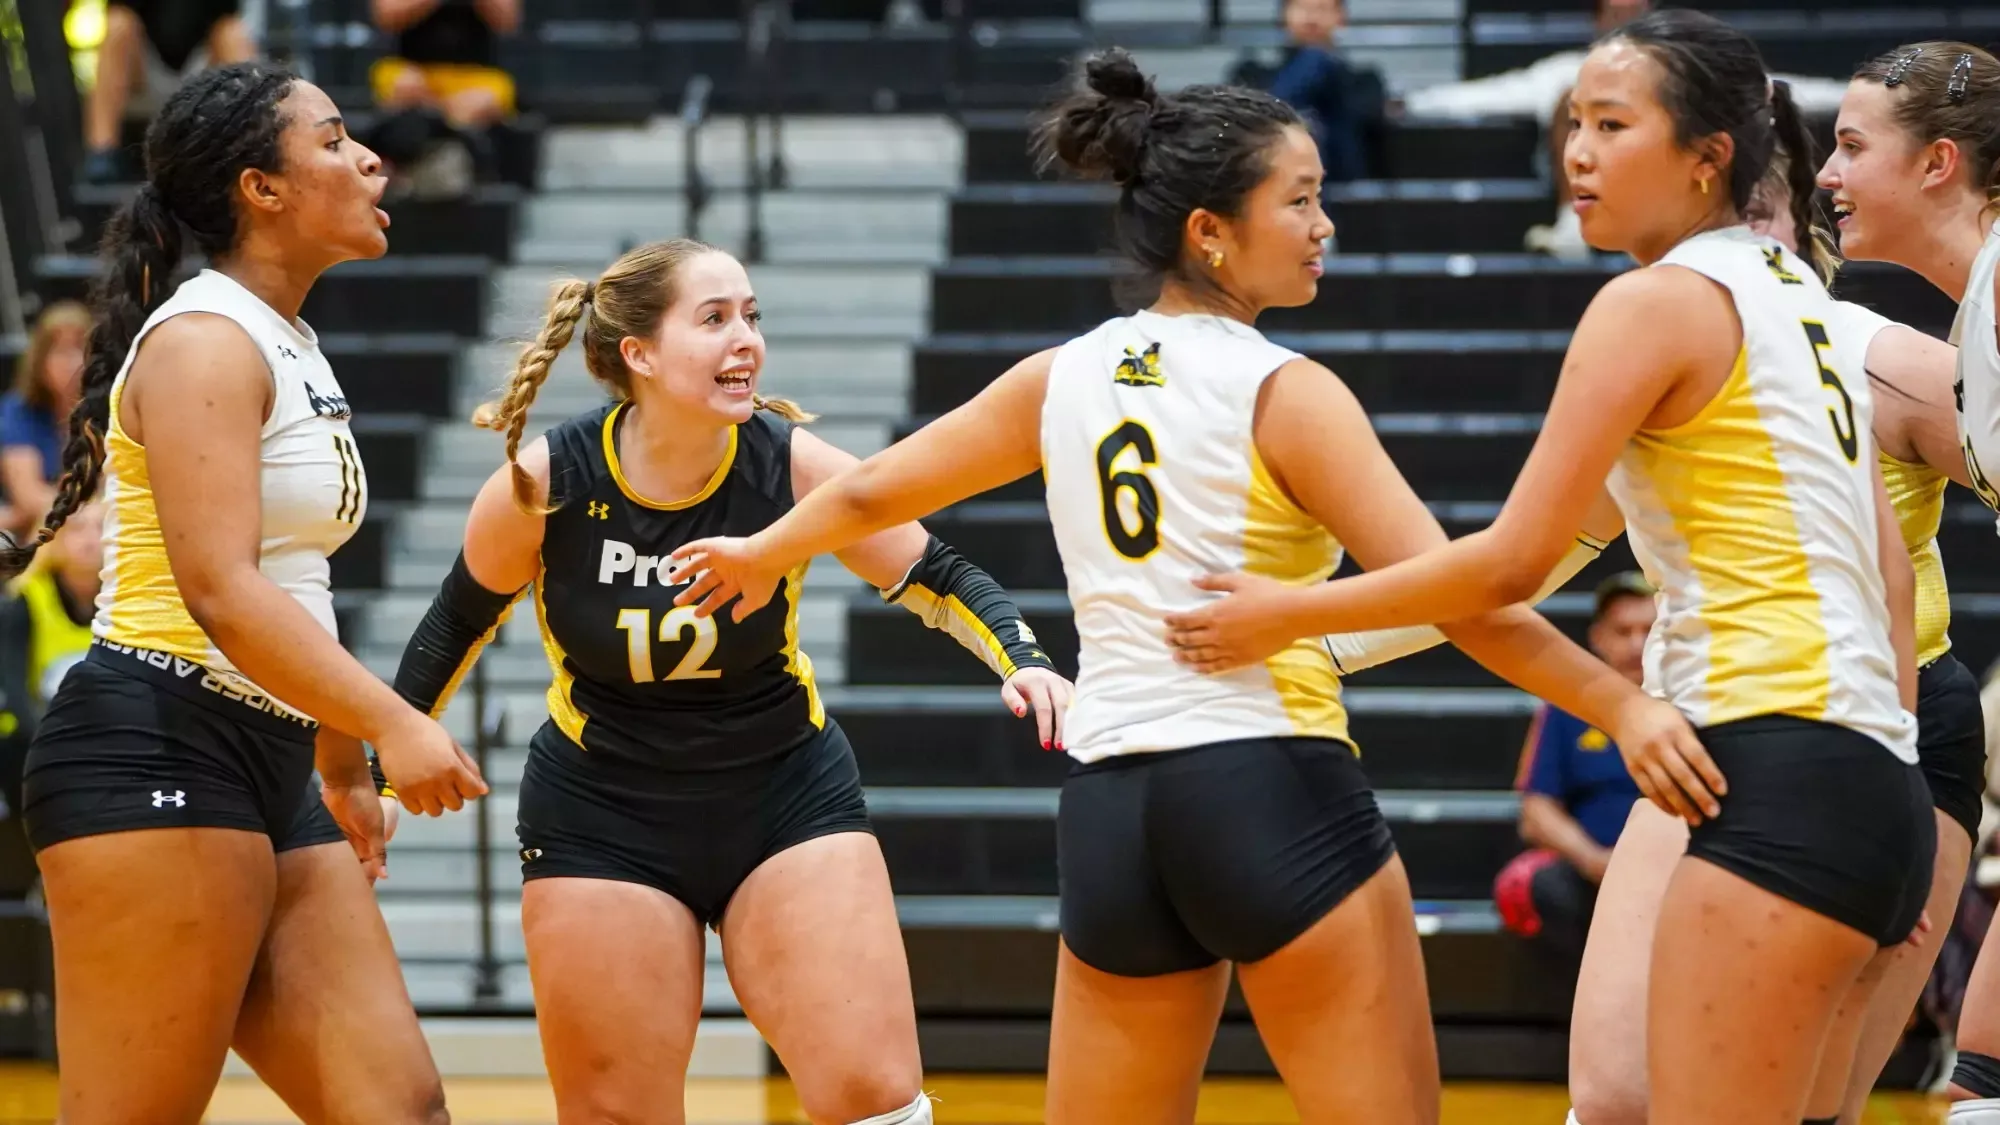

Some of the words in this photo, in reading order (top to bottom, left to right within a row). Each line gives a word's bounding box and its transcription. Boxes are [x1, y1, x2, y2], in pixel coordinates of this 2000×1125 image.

[1799, 318, 1859, 467] 5
[332, 434, 361, 525] 11
[1095, 415, 1163, 563] 6
[615, 604, 722, 684] 12
